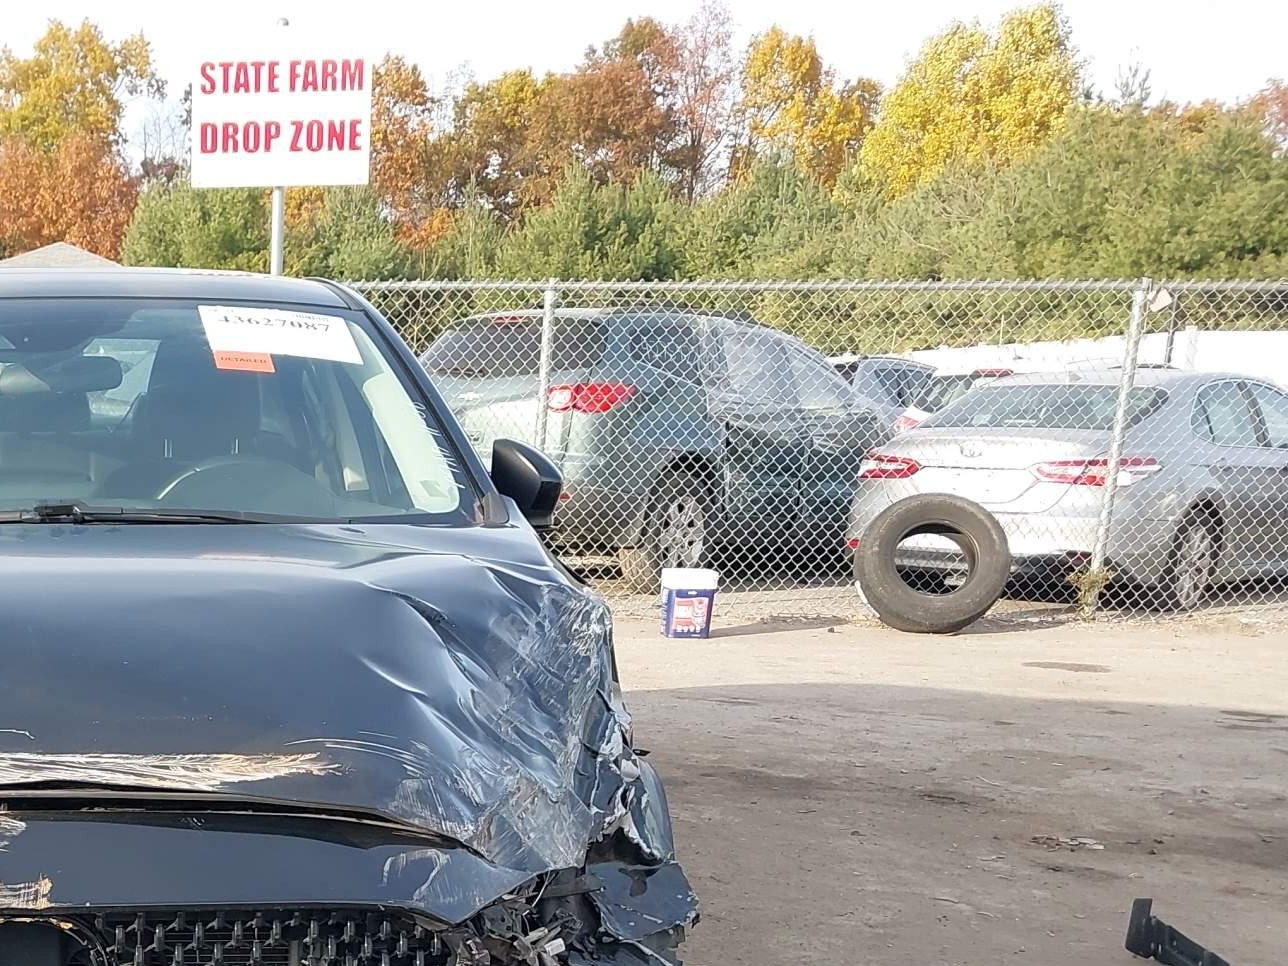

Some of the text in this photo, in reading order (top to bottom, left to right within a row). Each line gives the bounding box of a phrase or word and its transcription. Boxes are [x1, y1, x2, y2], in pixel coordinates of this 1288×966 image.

[200, 59, 364, 94] STATE FARM
[200, 119, 362, 154] DROP ZONE
